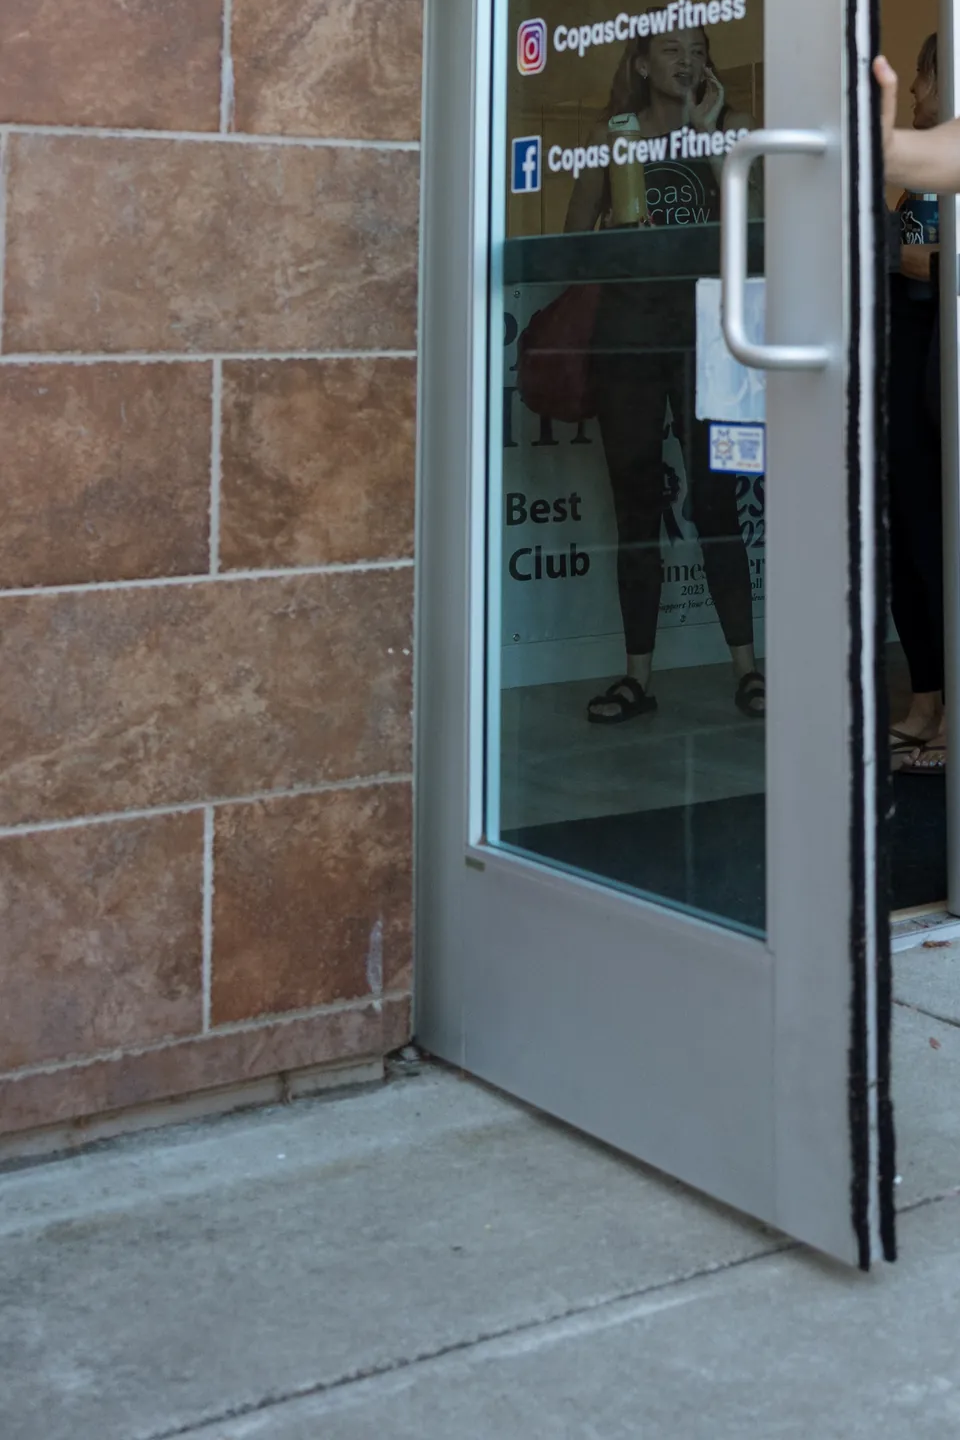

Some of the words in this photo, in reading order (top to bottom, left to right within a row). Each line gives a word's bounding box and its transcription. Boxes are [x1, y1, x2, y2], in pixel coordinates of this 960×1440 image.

[548, 140, 610, 179] Copas
[612, 136, 669, 165] Crew
[505, 491, 582, 526] Best
[508, 542, 591, 582] Club
[680, 583, 705, 596] 2023
